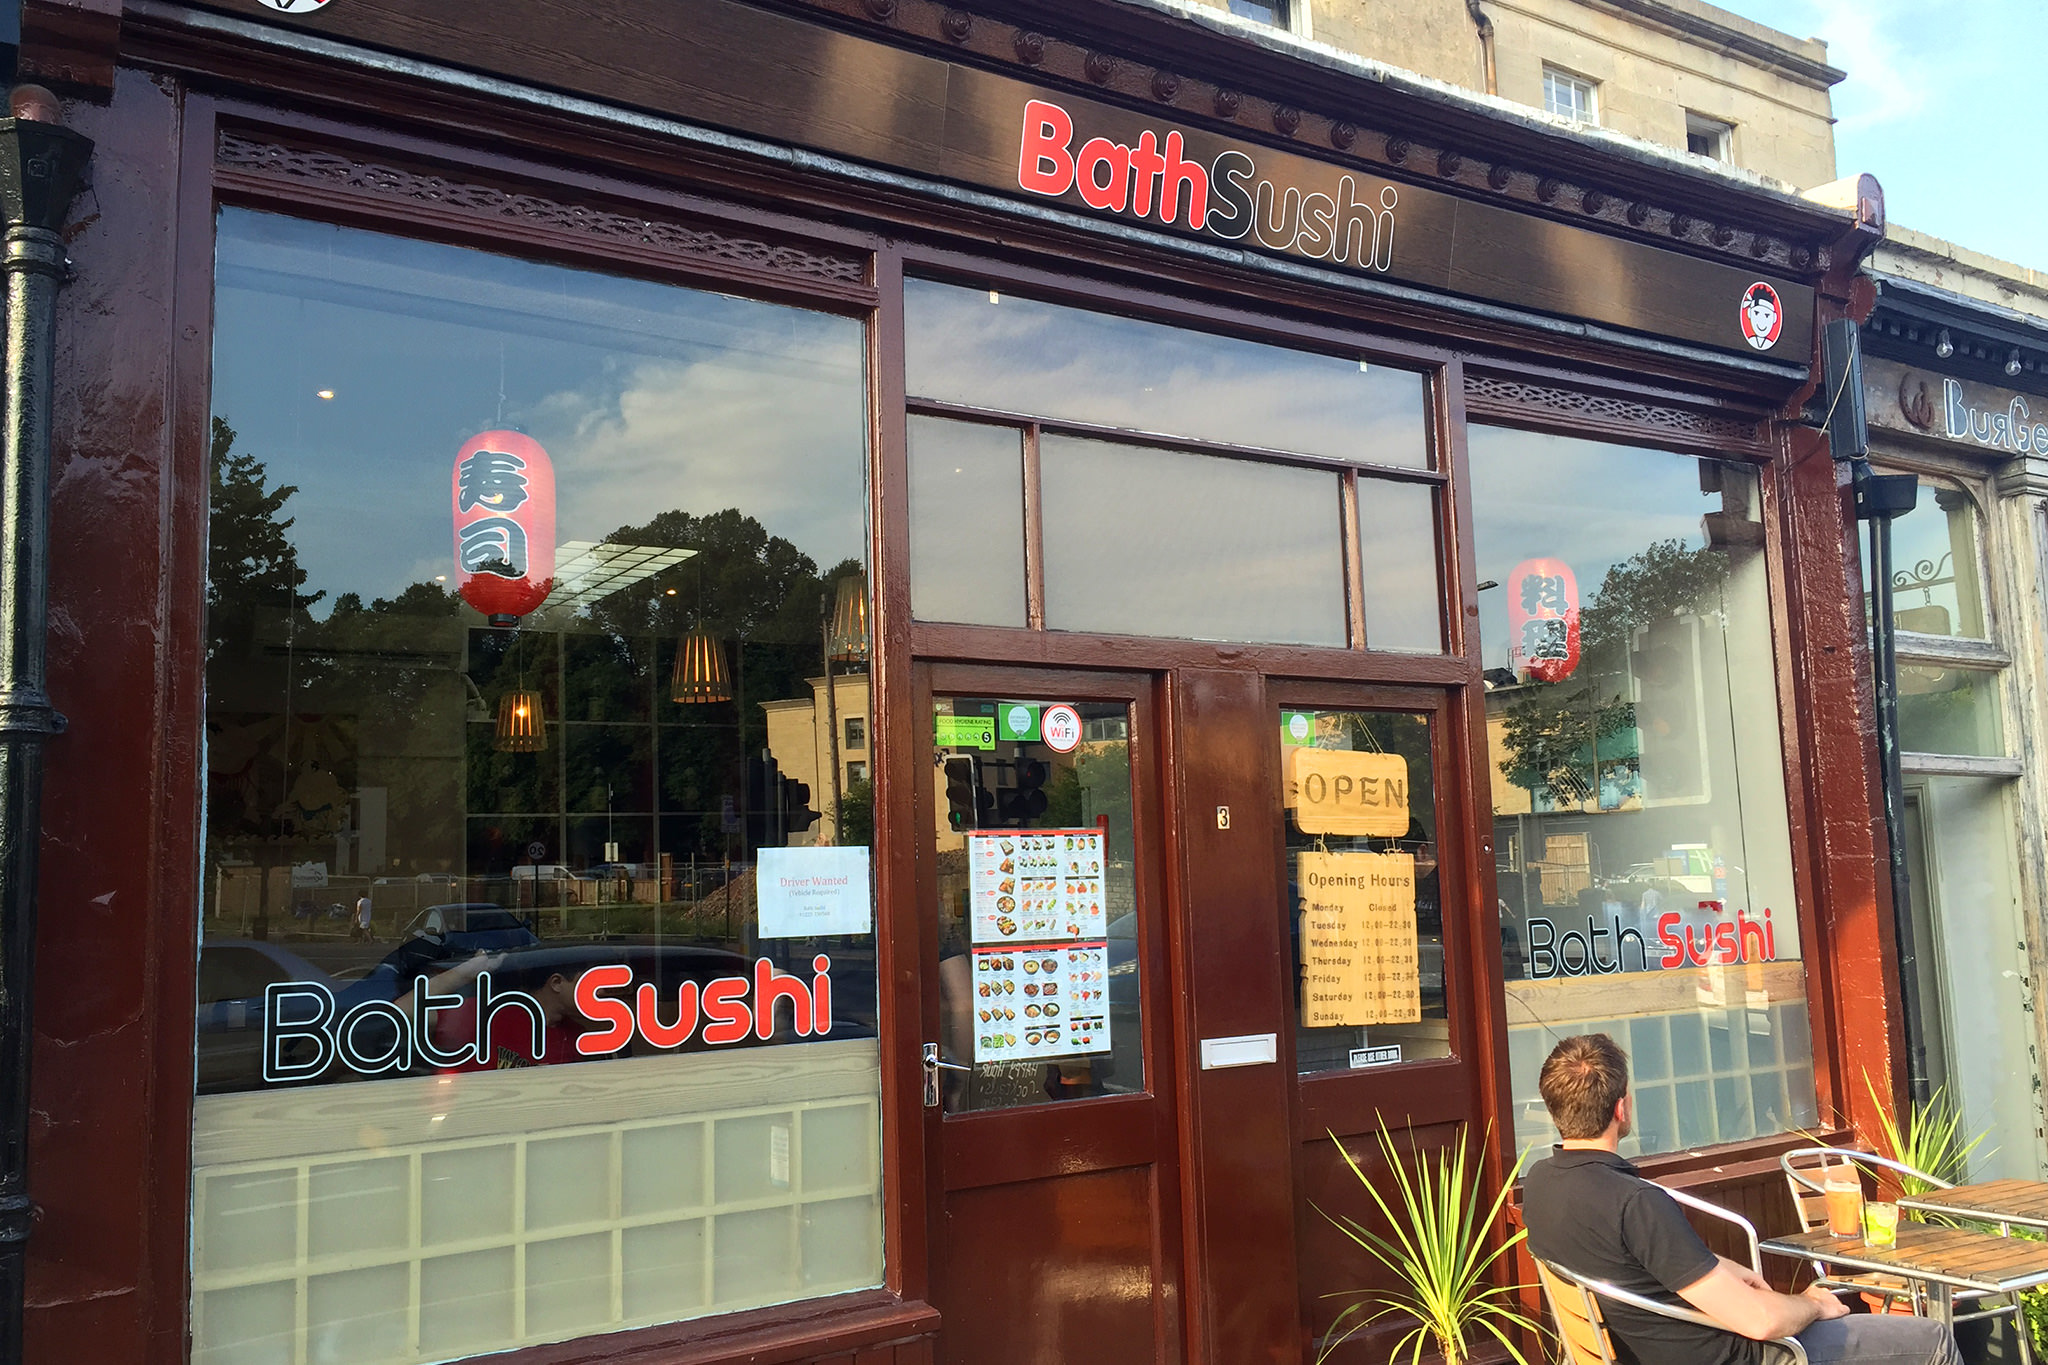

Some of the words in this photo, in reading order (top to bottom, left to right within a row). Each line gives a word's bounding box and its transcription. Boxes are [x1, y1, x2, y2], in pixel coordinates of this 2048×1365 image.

[1305, 773, 1403, 808] OPEN
[1219, 808, 1228, 827] 3
[780, 877, 809, 888] Driver
[811, 875, 848, 886] Wanted
[1308, 872, 1365, 889] Opening
[1370, 874, 1410, 887] Hours
[1312, 903, 1344, 913] Monday
[1368, 903, 1397, 912] Closed
[1312, 921, 1346, 931] Tuesday
[1311, 939, 1358, 949] Wednesday
[1527, 914, 1648, 980] Bath
[1657, 907, 1776, 969] Sushi
[1312, 956, 1351, 967] Thursday
[1312, 974, 1341, 984] Friday
[1312, 992, 1353, 1002] Saturday
[263, 971, 546, 1083] Bath
[574, 953, 833, 1056] Sushi
[1313, 1012, 1344, 1021] Sunday
